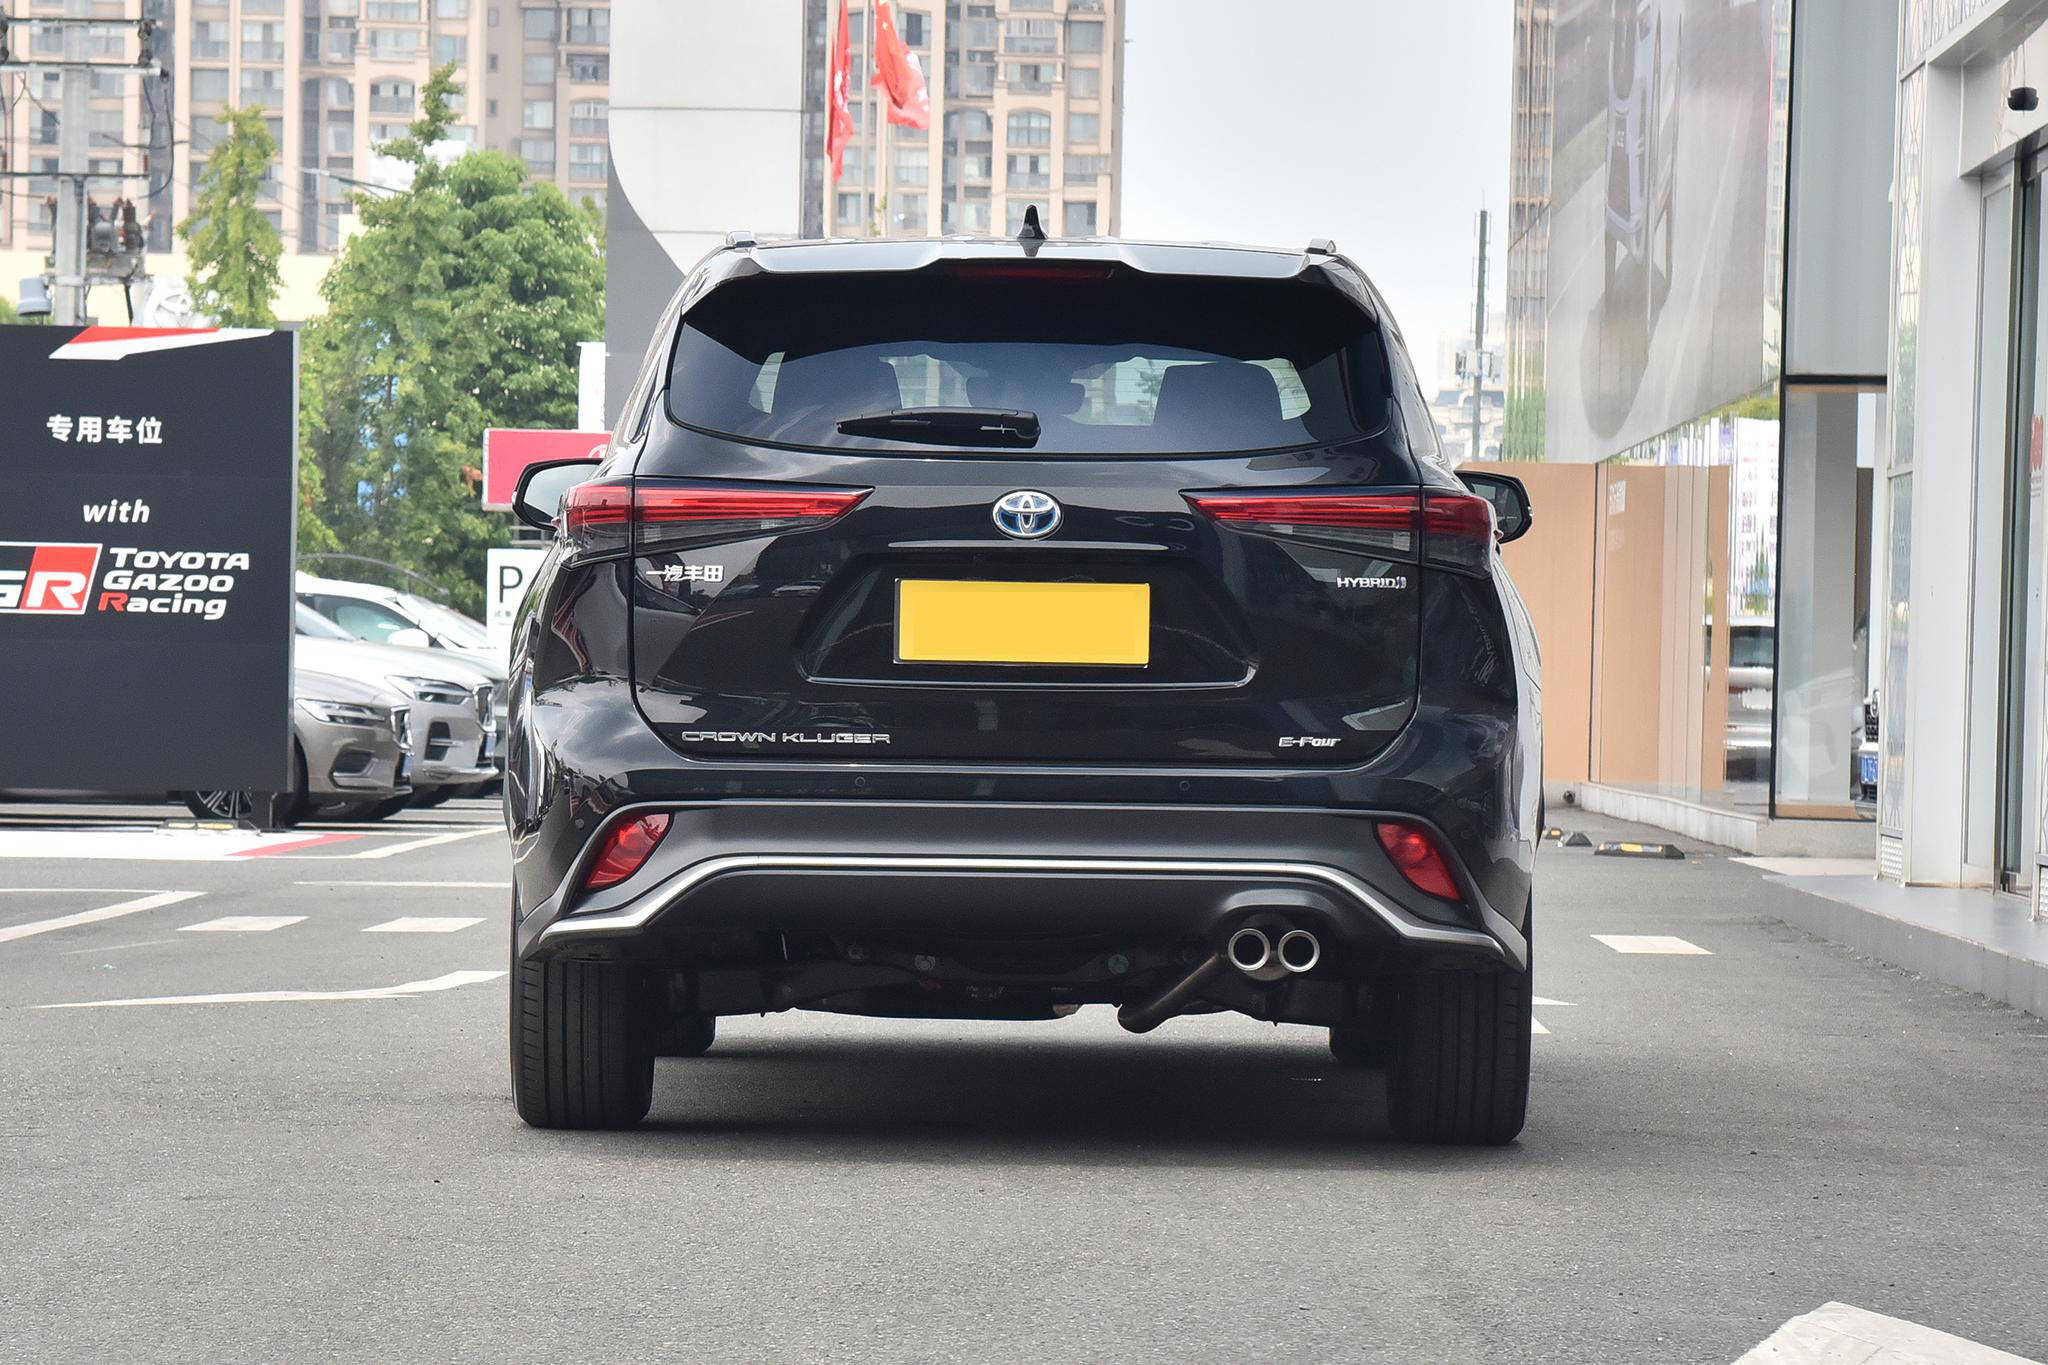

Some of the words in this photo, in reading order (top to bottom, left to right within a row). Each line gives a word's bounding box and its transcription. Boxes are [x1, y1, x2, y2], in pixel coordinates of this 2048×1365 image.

[46, 414, 163, 444] 专用车位
[83, 499, 150, 523] with
[109, 547, 250, 570] TOYOTA
[103, 570, 234, 592] GAZOO
[499, 565, 523, 603] P
[646, 565, 724, 582] 一汽丰田
[1336, 576, 1397, 588] HYBRID
[98, 592, 227, 620] Racing
[681, 731, 776, 742] CROWN
[782, 732, 891, 744] KLUGER
[1278, 736, 1342, 747] E-Four
